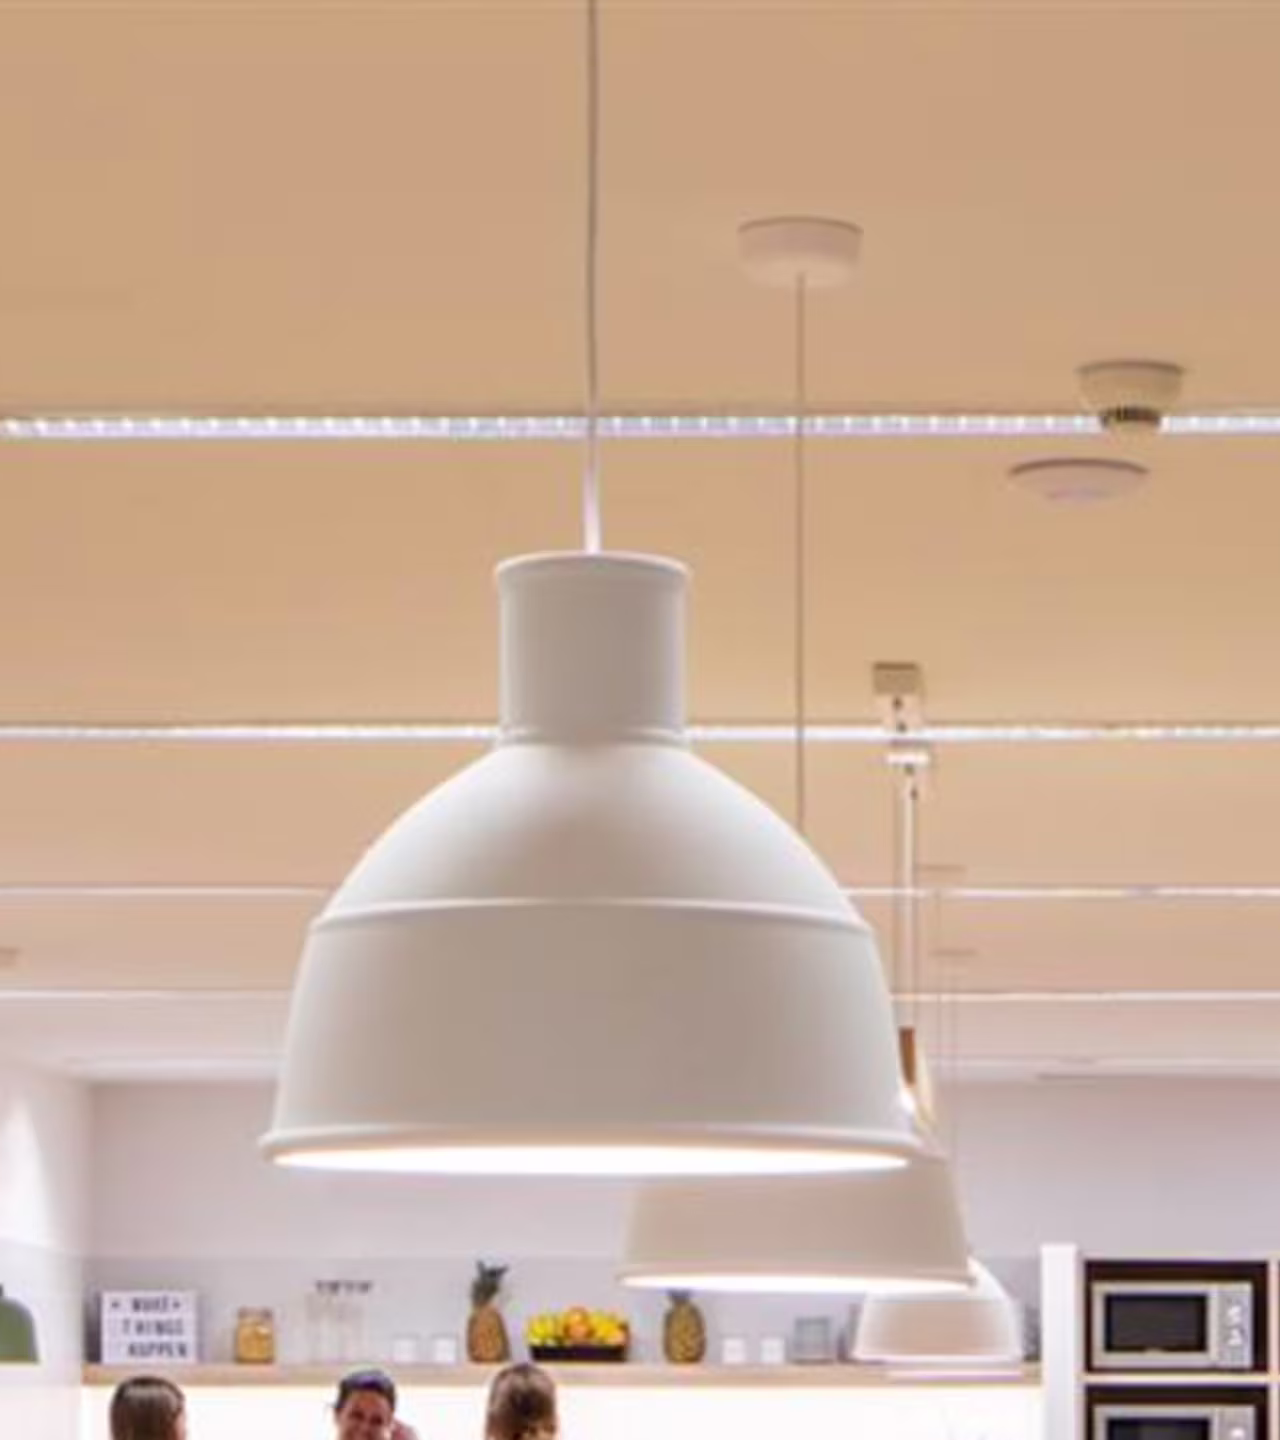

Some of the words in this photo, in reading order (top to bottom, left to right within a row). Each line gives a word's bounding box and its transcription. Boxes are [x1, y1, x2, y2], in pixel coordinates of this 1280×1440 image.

[132, 1296, 169, 1313] MAKE
[122, 1318, 184, 1335] THINGS
[128, 1342, 187, 1357] HAPPEN
